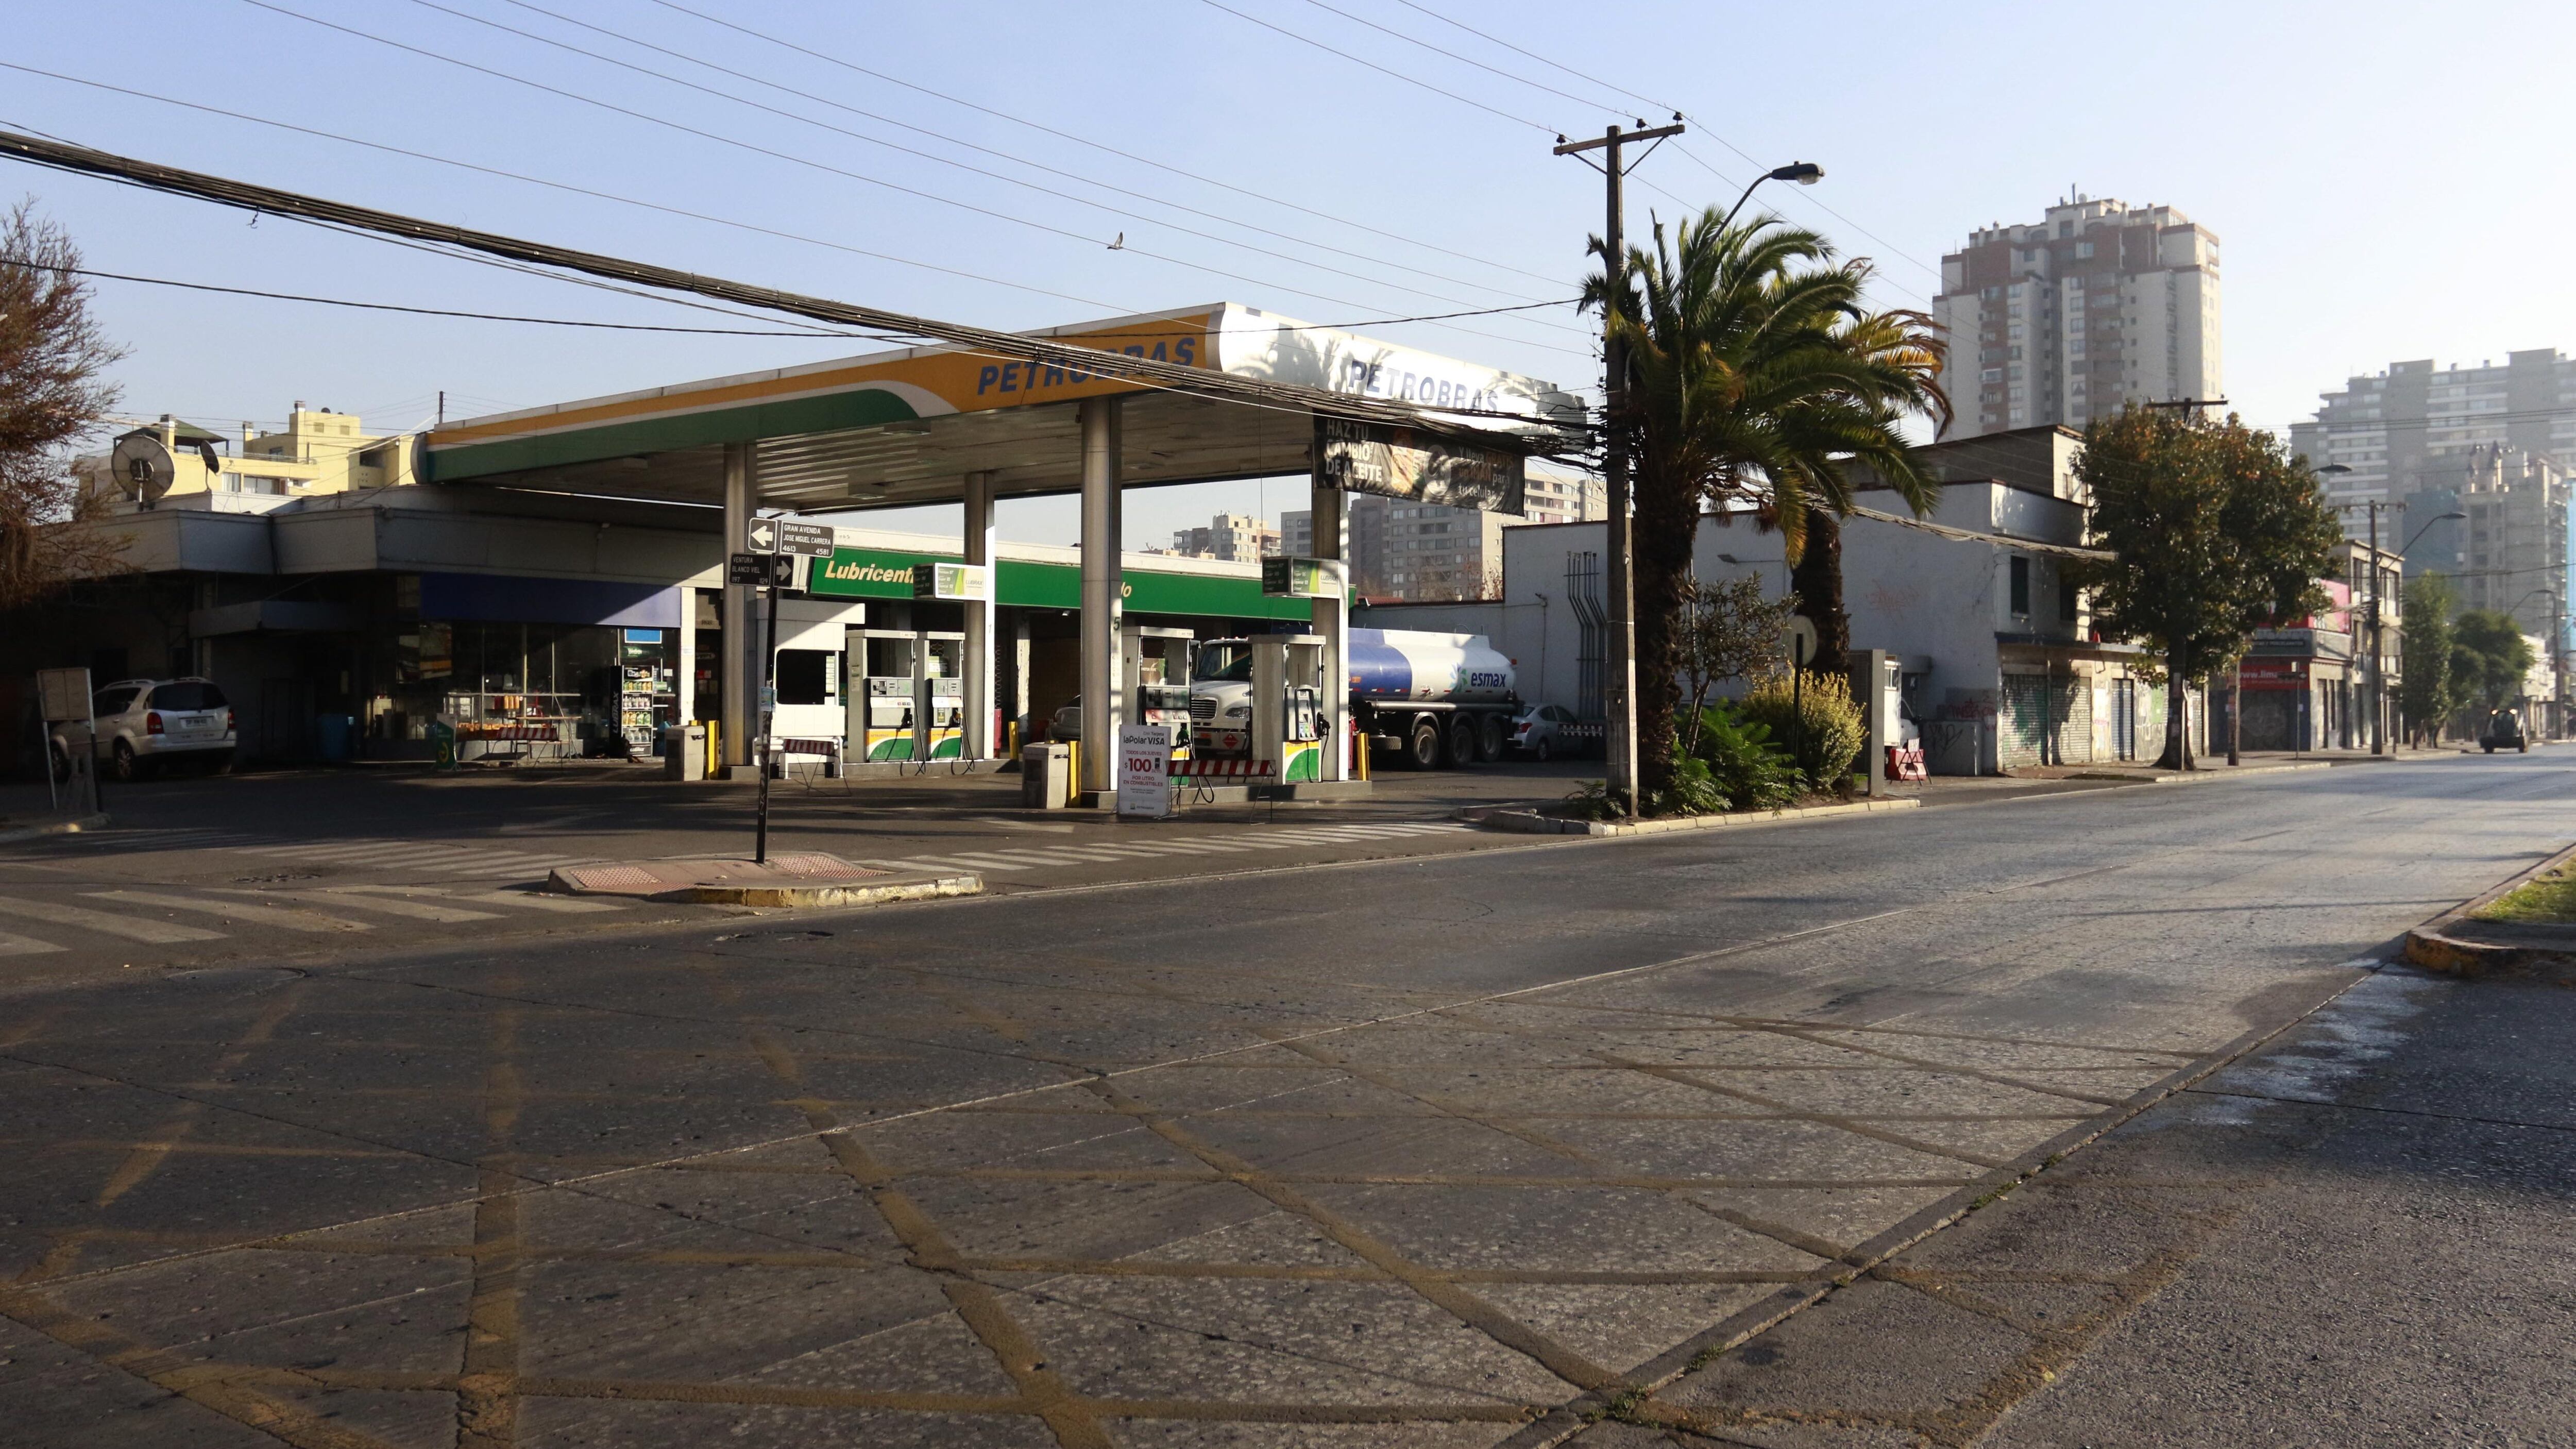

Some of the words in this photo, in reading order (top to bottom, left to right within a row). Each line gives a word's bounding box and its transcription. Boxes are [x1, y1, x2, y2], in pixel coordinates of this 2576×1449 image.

[1348, 359, 1498, 412] PETROBRAS
[1327, 419, 1351, 437] HAZ
[1353, 424, 1369, 440] TU
[1326, 439, 1370, 461] CAMBIO
[1459, 446, 1464, 458] Y
[1466, 448, 1484, 462] lleva
[1326, 458, 1341, 475] DE
[1343, 461, 1382, 482] ACEITE
[1493, 474, 1510, 487] para
[1459, 483, 1468, 495] tu
[1469, 485, 1496, 498] celular
[799, 526, 821, 534] AVENIDA
[811, 537, 831, 545] CARRERA
[1113, 617, 1121, 631] 5
[1471, 672, 1506, 687] esmax
[1128, 758, 1151, 772] 100
